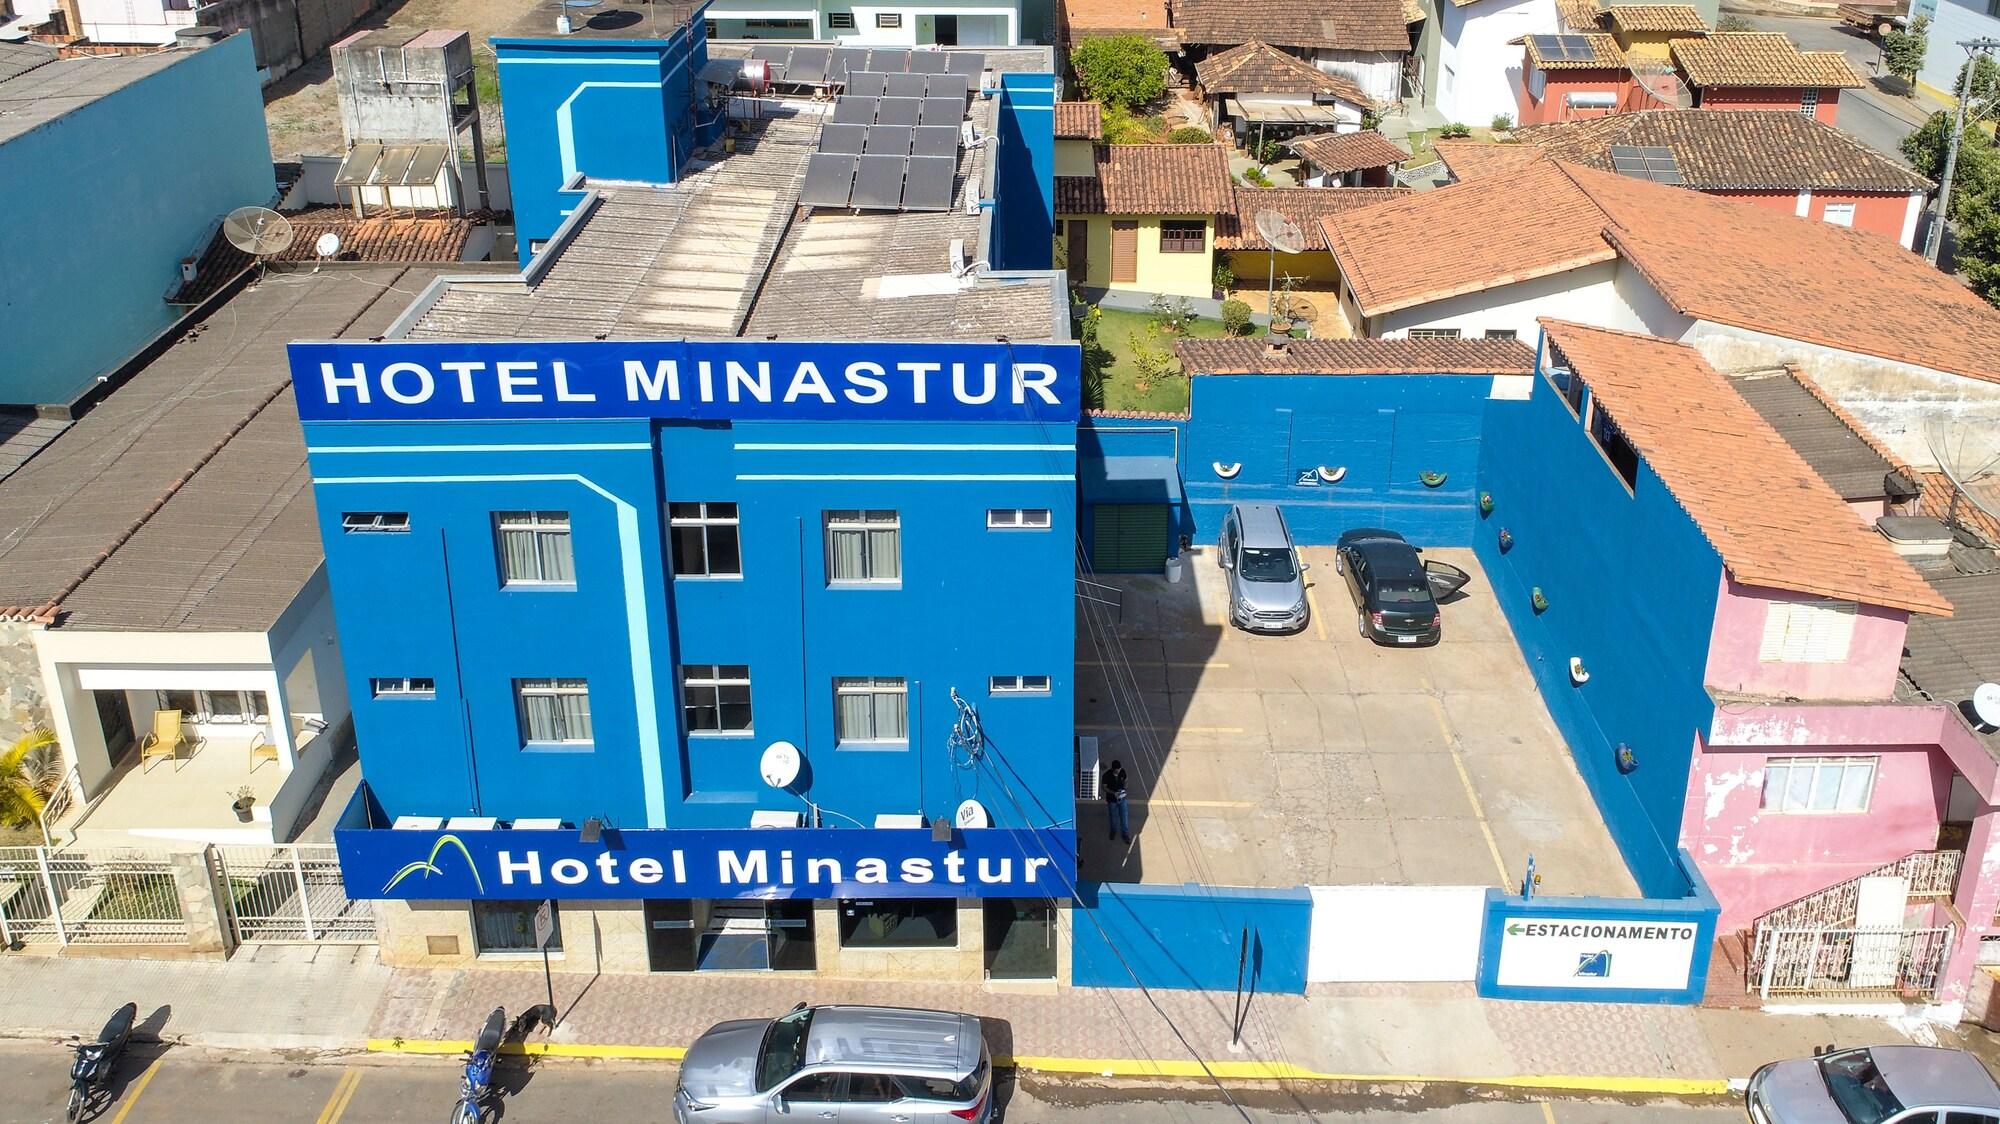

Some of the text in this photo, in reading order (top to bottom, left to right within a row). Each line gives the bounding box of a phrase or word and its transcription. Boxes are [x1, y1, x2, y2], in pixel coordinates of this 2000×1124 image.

[320, 360, 1061, 405] HOTEL MINASTUR
[498, 849, 1049, 885] Hotel Minastur
[1525, 924, 1693, 940] ESTACIONAMENTO
